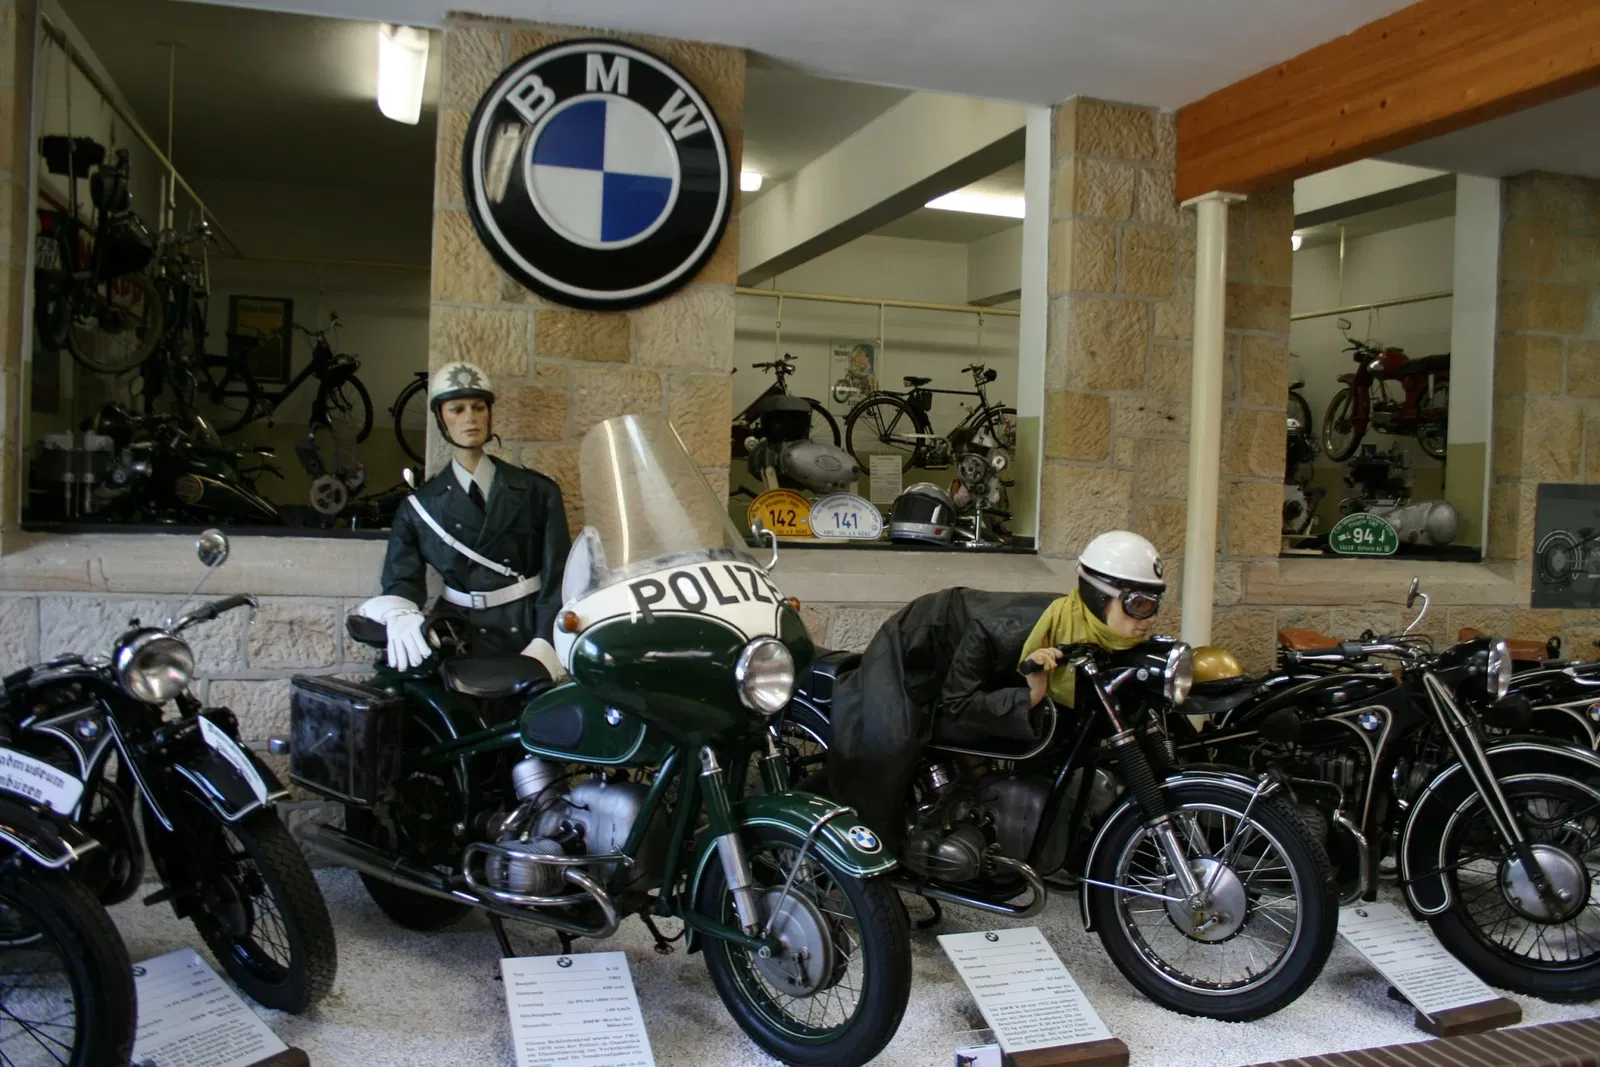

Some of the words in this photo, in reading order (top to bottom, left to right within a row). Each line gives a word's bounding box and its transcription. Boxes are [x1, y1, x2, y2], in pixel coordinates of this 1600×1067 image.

[505, 53, 707, 142] BMW
[769, 509, 797, 527] 142
[832, 511, 858, 529] 141
[1352, 527, 1375, 544] 94
